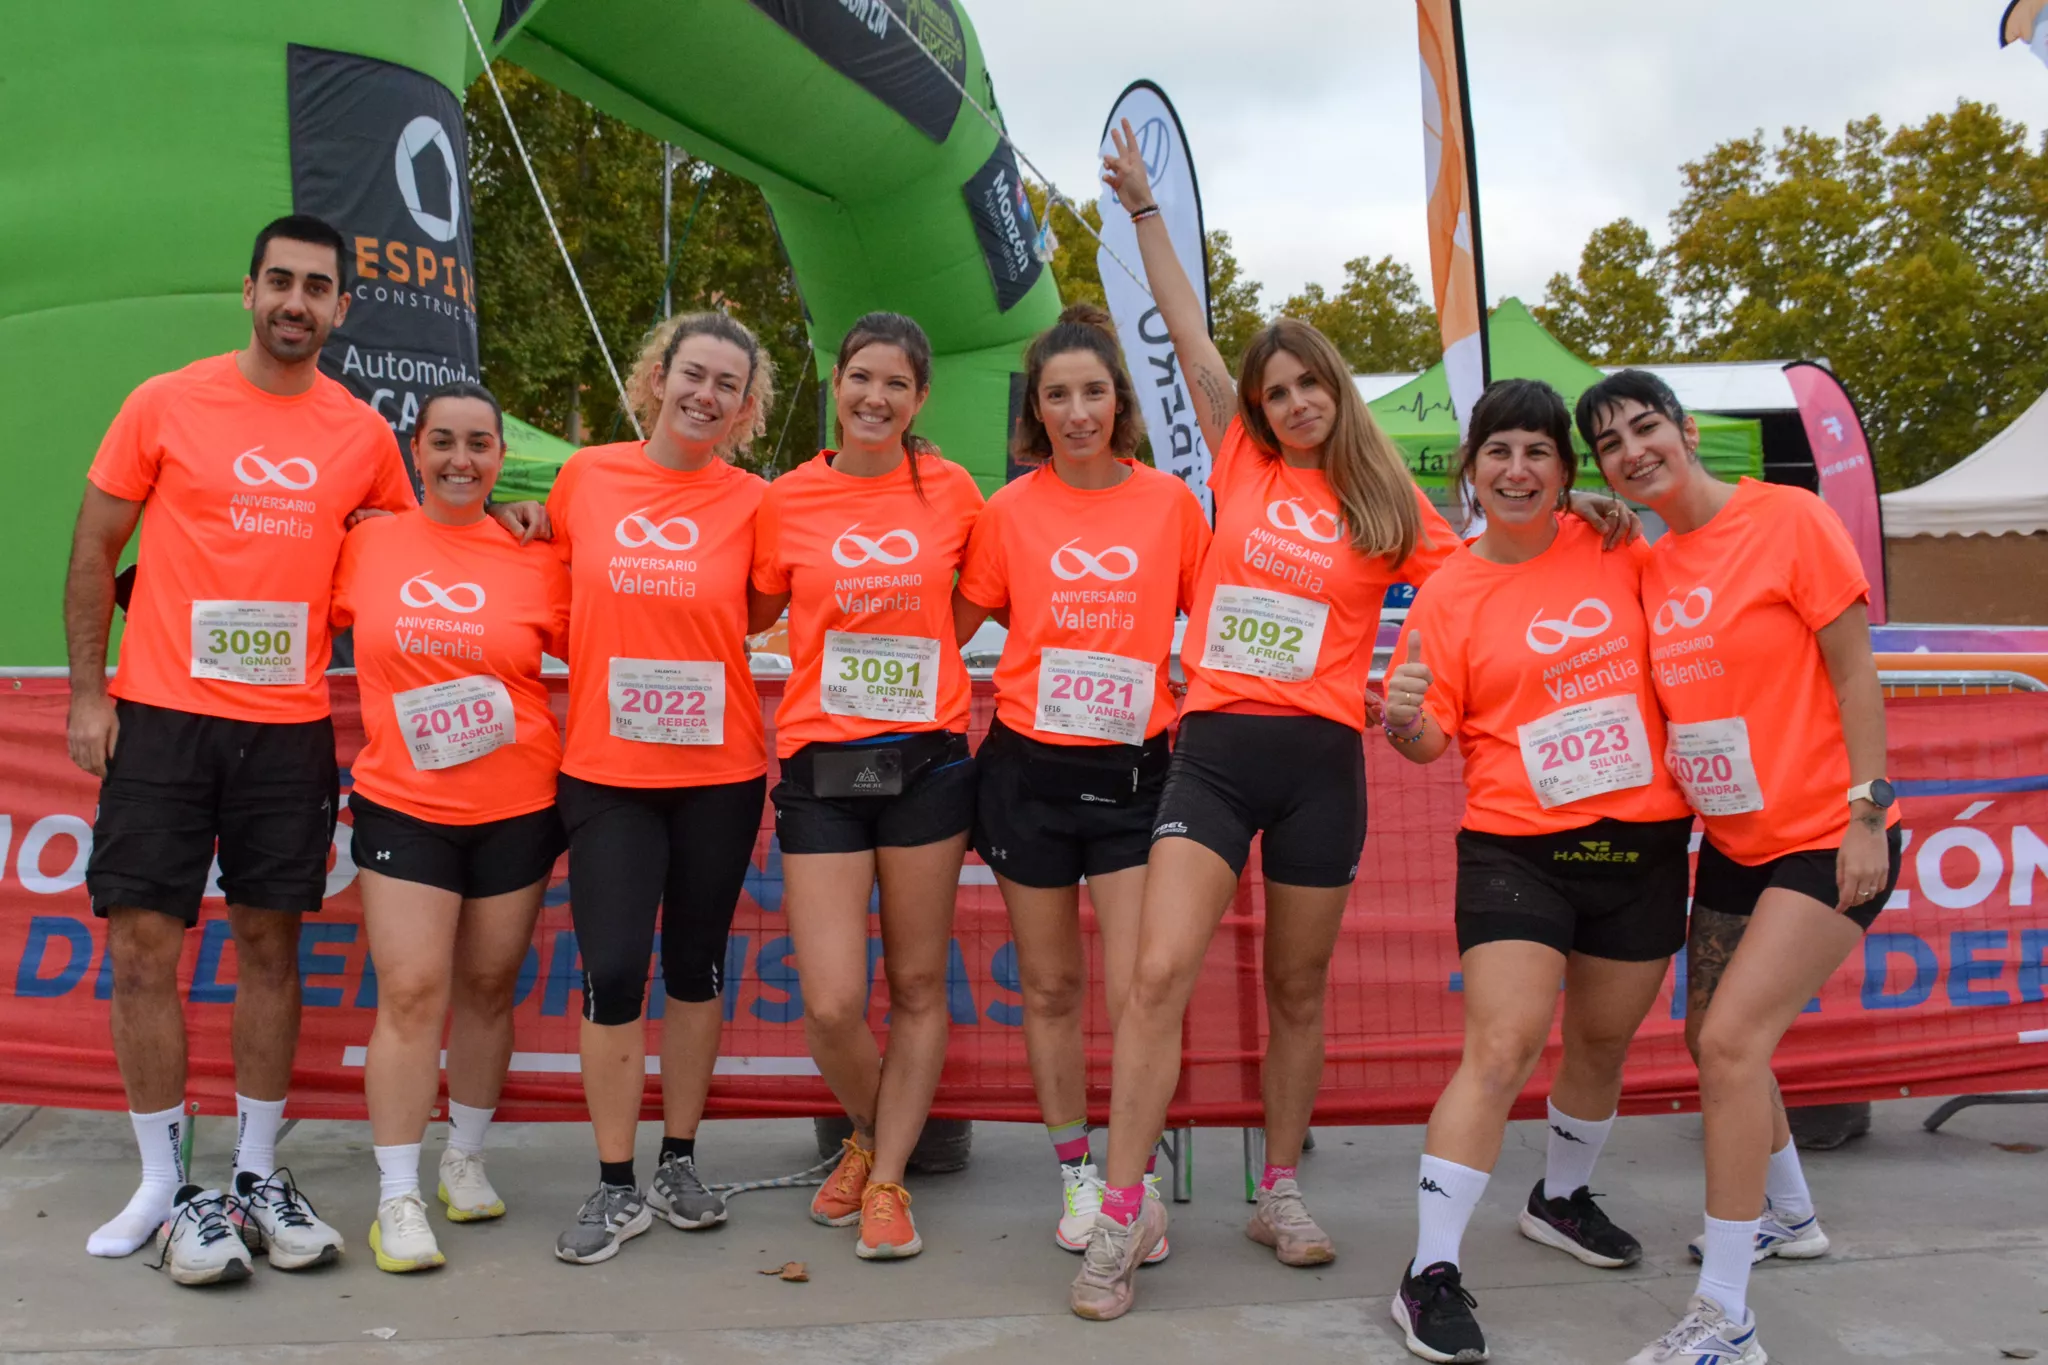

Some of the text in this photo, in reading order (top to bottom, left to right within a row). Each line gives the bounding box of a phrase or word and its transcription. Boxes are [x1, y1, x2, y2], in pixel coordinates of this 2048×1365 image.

[992, 168, 1030, 274] Monzón
[230, 494, 316, 513] ANIVERSARIO
[230, 506, 313, 539] Valentia
[1250, 527, 1333, 569] ANIVERSARIO
[609, 556, 697, 572] ANIVERSARIO
[1243, 538, 1324, 593] Valentia
[608, 570, 695, 597] Valentia
[834, 574, 922, 591] ANIVERSARIO
[1402, 585, 1414, 598] 2
[835, 592, 920, 614] Valentia
[1051, 591, 1136, 603] ANIVERSARIO
[395, 616, 484, 636] ANIVERSARIO
[1051, 606, 1134, 630] Valentia
[208, 629, 291, 654] 3090
[395, 629, 483, 661] Valentia
[1219, 615, 1303, 653] 3092
[240, 657, 291, 666] IGNACIO
[1247, 646, 1294, 664] AFRICA
[1542, 635, 1629, 681] ANIVERSARIO
[839, 656, 920, 687] 3091
[1544, 657, 1639, 703] Valentia
[621, 689, 705, 715] 2022
[867, 685, 924, 698] CRISTINA
[1051, 674, 1133, 708] 2021
[411, 700, 493, 738] 2019
[658, 717, 707, 727] REBECA
[1087, 705, 1135, 721] VANESA
[448, 723, 503, 743] IZASKUN
[1538, 724, 1629, 771] 2023
[1590, 753, 1633, 770] SILVIA
[1539, 776, 1559, 788] EF16
[1695, 784, 1741, 795] SANDRA
[1553, 850, 1640, 863] HANKER
